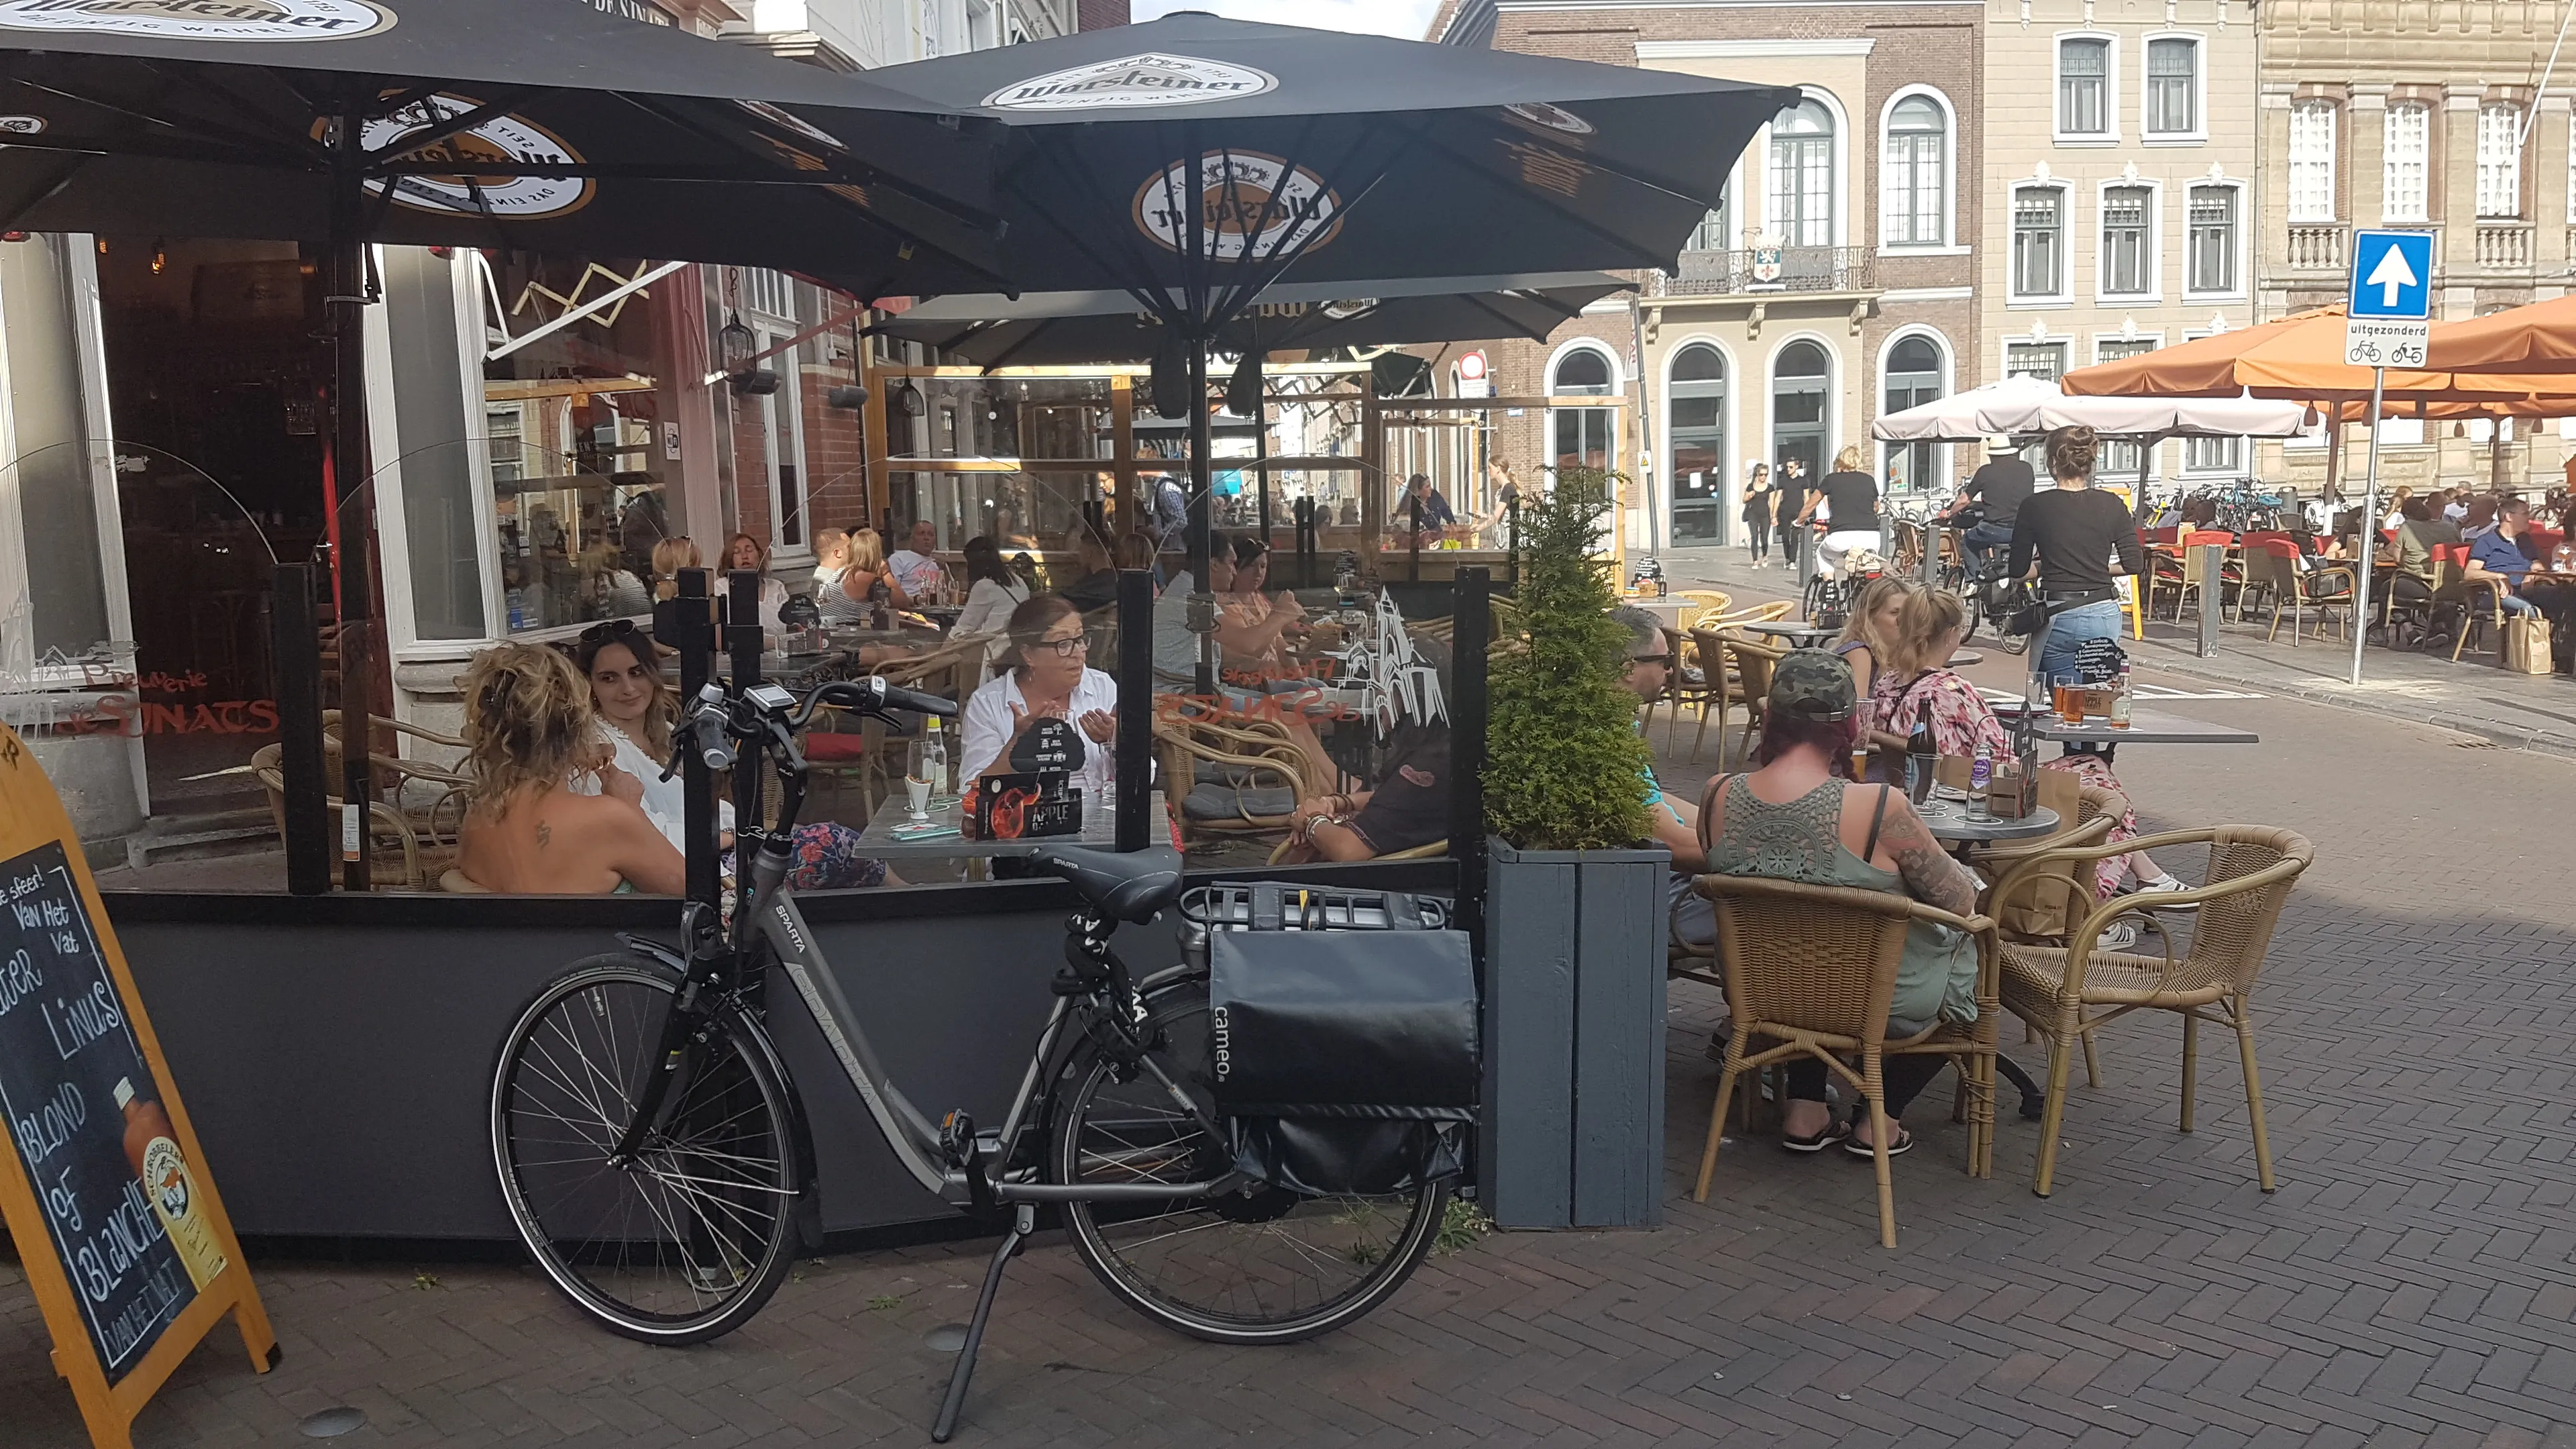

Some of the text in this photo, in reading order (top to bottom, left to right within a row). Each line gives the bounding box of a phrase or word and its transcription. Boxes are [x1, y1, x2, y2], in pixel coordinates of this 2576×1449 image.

[1012, 69, 1252, 100] Warsteiner
[2351, 324, 2427, 337] uitgezonderd
[78, 662, 208, 693] Preuverie
[1053, 857, 1079, 870] SPARTA
[9, 863, 46, 901] sfeer!
[775, 905, 806, 953] SPARTA
[19, 1081, 85, 1163] BLOND
